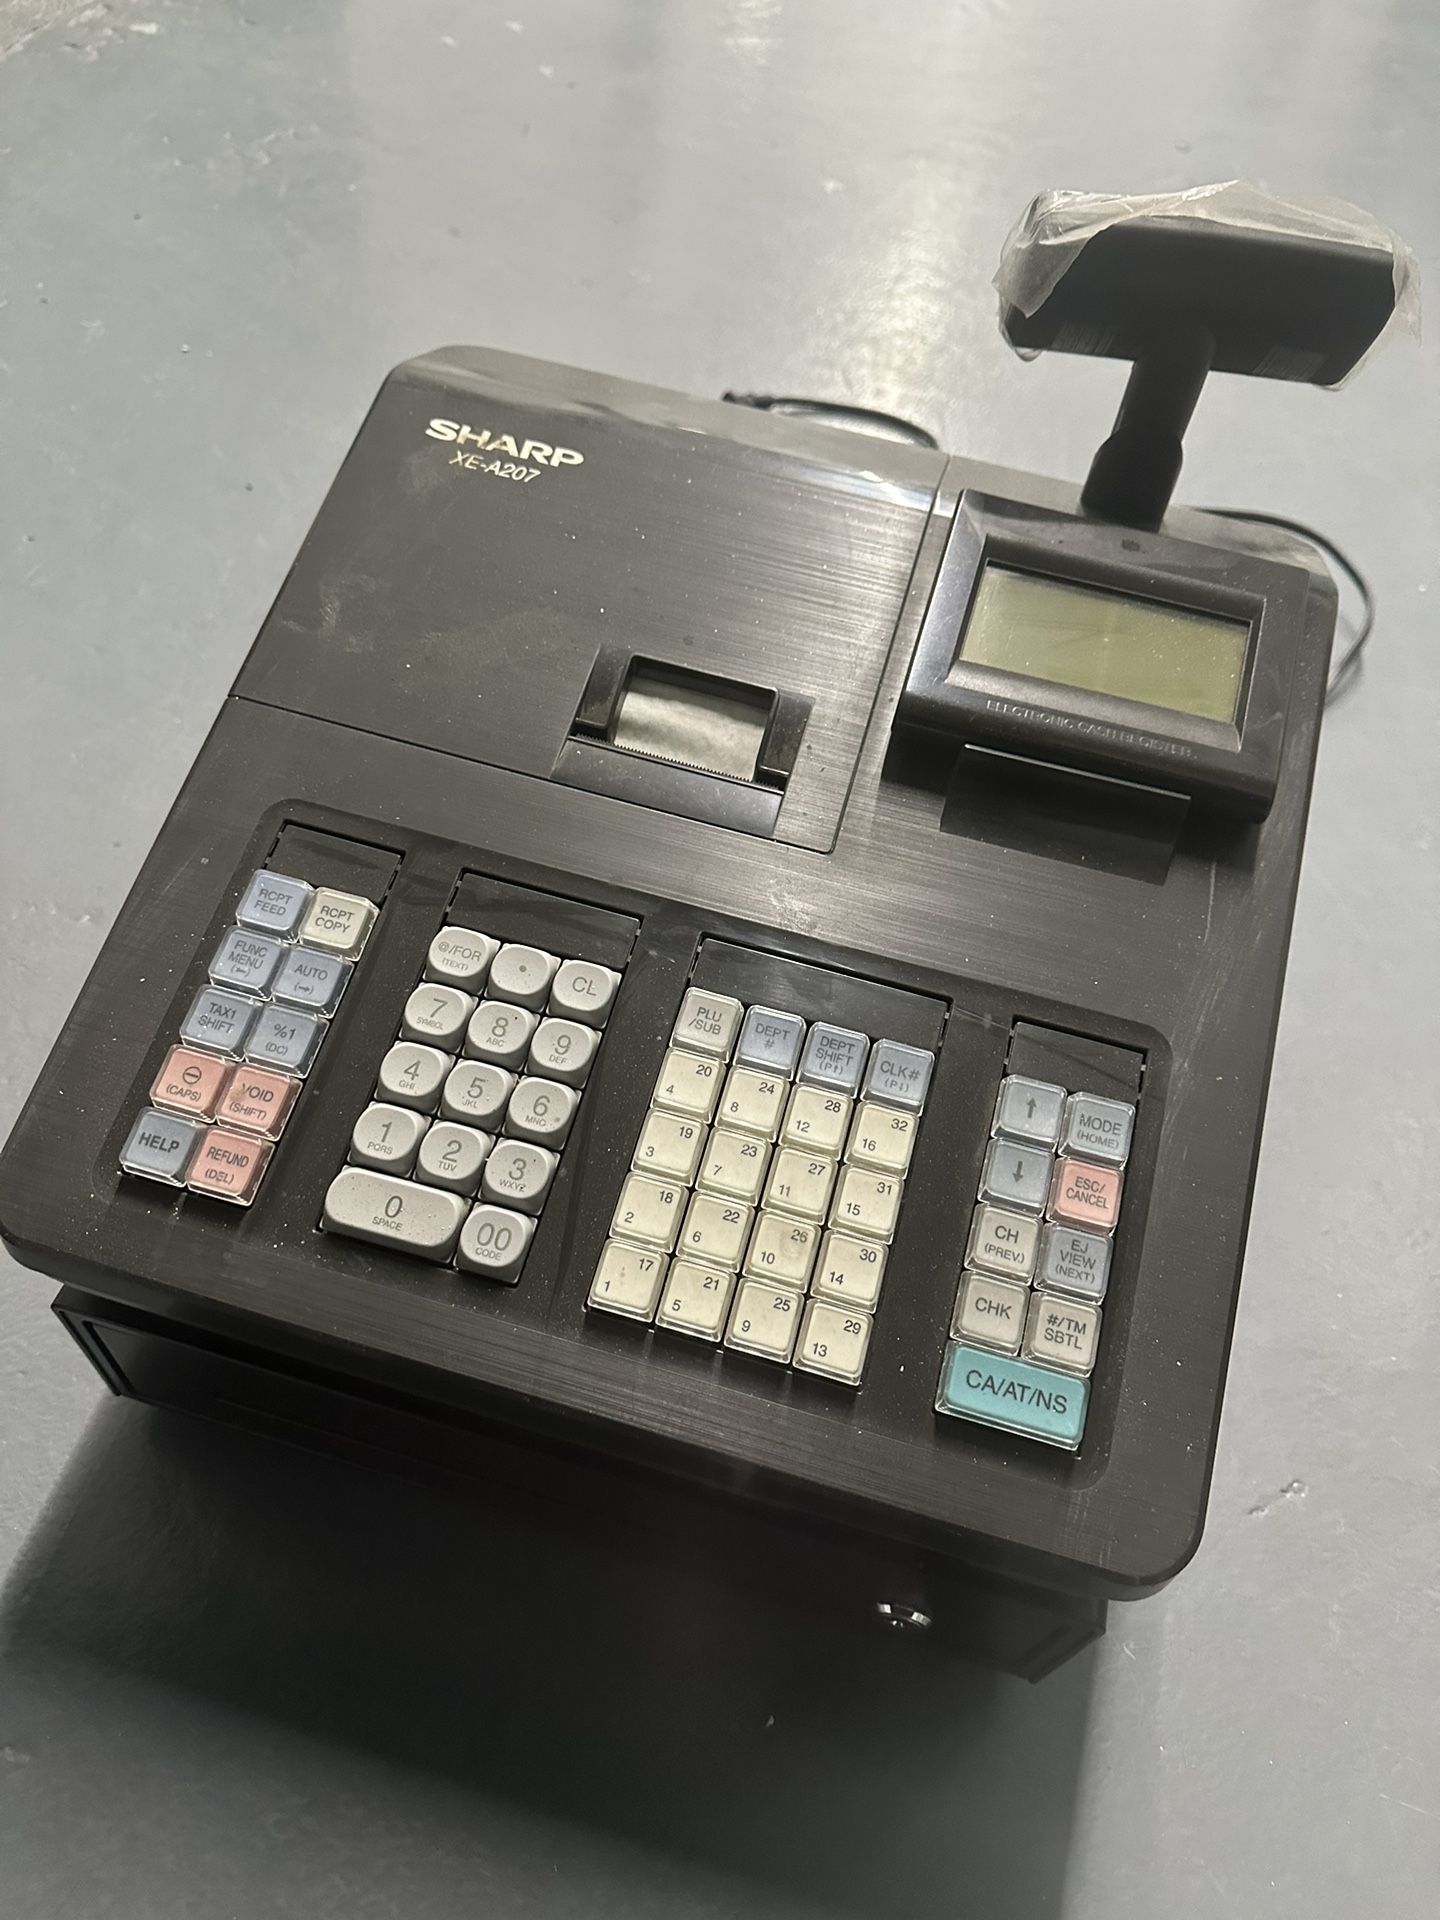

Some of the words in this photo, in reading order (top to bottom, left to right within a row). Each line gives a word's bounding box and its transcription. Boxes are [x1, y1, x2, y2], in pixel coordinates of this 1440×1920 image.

[425, 418, 584, 467] SHARP
[449, 450, 541, 483] XE-A207
[258, 888, 293, 905] RCPT
[254, 901, 287, 916] FEED
[320, 905, 354, 921] RCPT
[315, 917, 351, 934] COPY
[234, 940, 268, 957] FUNC
[228, 952, 263, 969] MENU
[294, 964, 328, 981] AUTO
[572, 977, 597, 996] CL
[209, 1002, 237, 1019] TAX1
[430, 998, 448, 1018] 7
[697, 1007, 723, 1023] PLU
[198, 1015, 234, 1034] SHIFT
[274, 1023, 296, 1040] %1
[491, 1017, 509, 1038] 8
[688, 1017, 721, 1036] /SUB
[755, 1023, 791, 1041] DEPT
[265, 1041, 288, 1056] (DC)
[486, 1037, 505, 1048] ABC
[554, 1035, 572, 1055] 9
[820, 1035, 855, 1054] DEPT
[549, 1055, 567, 1065] DEF
[815, 1047, 853, 1066] SHIFT
[404, 1060, 421, 1081] 4
[695, 1064, 713, 1078] 20
[881, 1060, 920, 1081] CLK#
[166, 1083, 201, 1102] (CAPS)
[241, 1083, 274, 1102] VOID
[399, 1080, 415, 1090] GHI
[467, 1076, 487, 1099] 5
[666, 1084, 674, 1096] 4
[758, 1082, 775, 1095] 24
[229, 1102, 267, 1120] (SHIFT)
[462, 1099, 478, 1109] JKL
[533, 1095, 550, 1116] 6
[730, 1102, 739, 1113] 8
[825, 1100, 842, 1113] 28
[381, 1121, 393, 1143] 1
[678, 1126, 694, 1139] 19
[796, 1120, 810, 1133] 12
[891, 1118, 908, 1132] 32
[1080, 1113, 1122, 1136] MODE
[139, 1132, 180, 1152] HELP
[862, 1138, 876, 1152] 16
[1076, 1131, 1119, 1149] (HOME)
[206, 1146, 249, 1167] REFUND
[442, 1140, 462, 1163] 2
[646, 1146, 654, 1157] 3
[741, 1144, 758, 1158] 23
[438, 1162, 457, 1173] TUV
[508, 1158, 527, 1180] 3
[714, 1164, 723, 1176] 7
[808, 1163, 826, 1176] 27
[205, 1169, 234, 1185] (DEL)
[1075, 1176, 1105, 1192] ESC/
[499, 1179, 527, 1192] WXYZ
[779, 1184, 791, 1197] 11
[877, 1182, 892, 1195] 31
[659, 1190, 674, 1204] 18
[1066, 1189, 1109, 1209] CANCEL
[385, 1195, 403, 1219] 0
[846, 1202, 861, 1216] 15
[372, 1216, 403, 1231] SPACE
[624, 1212, 634, 1223] 2
[722, 1209, 740, 1223] 22
[476, 1223, 512, 1251] 00
[692, 1231, 701, 1243] 6
[790, 1229, 808, 1243] 26
[995, 1225, 1019, 1244] CH
[475, 1247, 501, 1261] CODE
[1071, 1239, 1089, 1254] EJ
[760, 1252, 775, 1265] 10
[859, 1249, 877, 1263] 30
[1060, 1249, 1096, 1270] VIEW
[639, 1258, 654, 1272] 17
[830, 1272, 844, 1286] 14
[1055, 1263, 1096, 1285] (NEXT)
[604, 1281, 611, 1292] 1
[703, 1277, 720, 1291] 21
[672, 1300, 681, 1311] 5
[774, 1297, 791, 1312] 25
[975, 1297, 1012, 1320] CHK
[741, 1321, 751, 1332] 9
[843, 1320, 861, 1335] 29
[1047, 1313, 1087, 1335] #/TM
[1044, 1328, 1082, 1350] SBTL
[812, 1343, 828, 1357] 13
[966, 1370, 1068, 1415] CA/AT/NS
